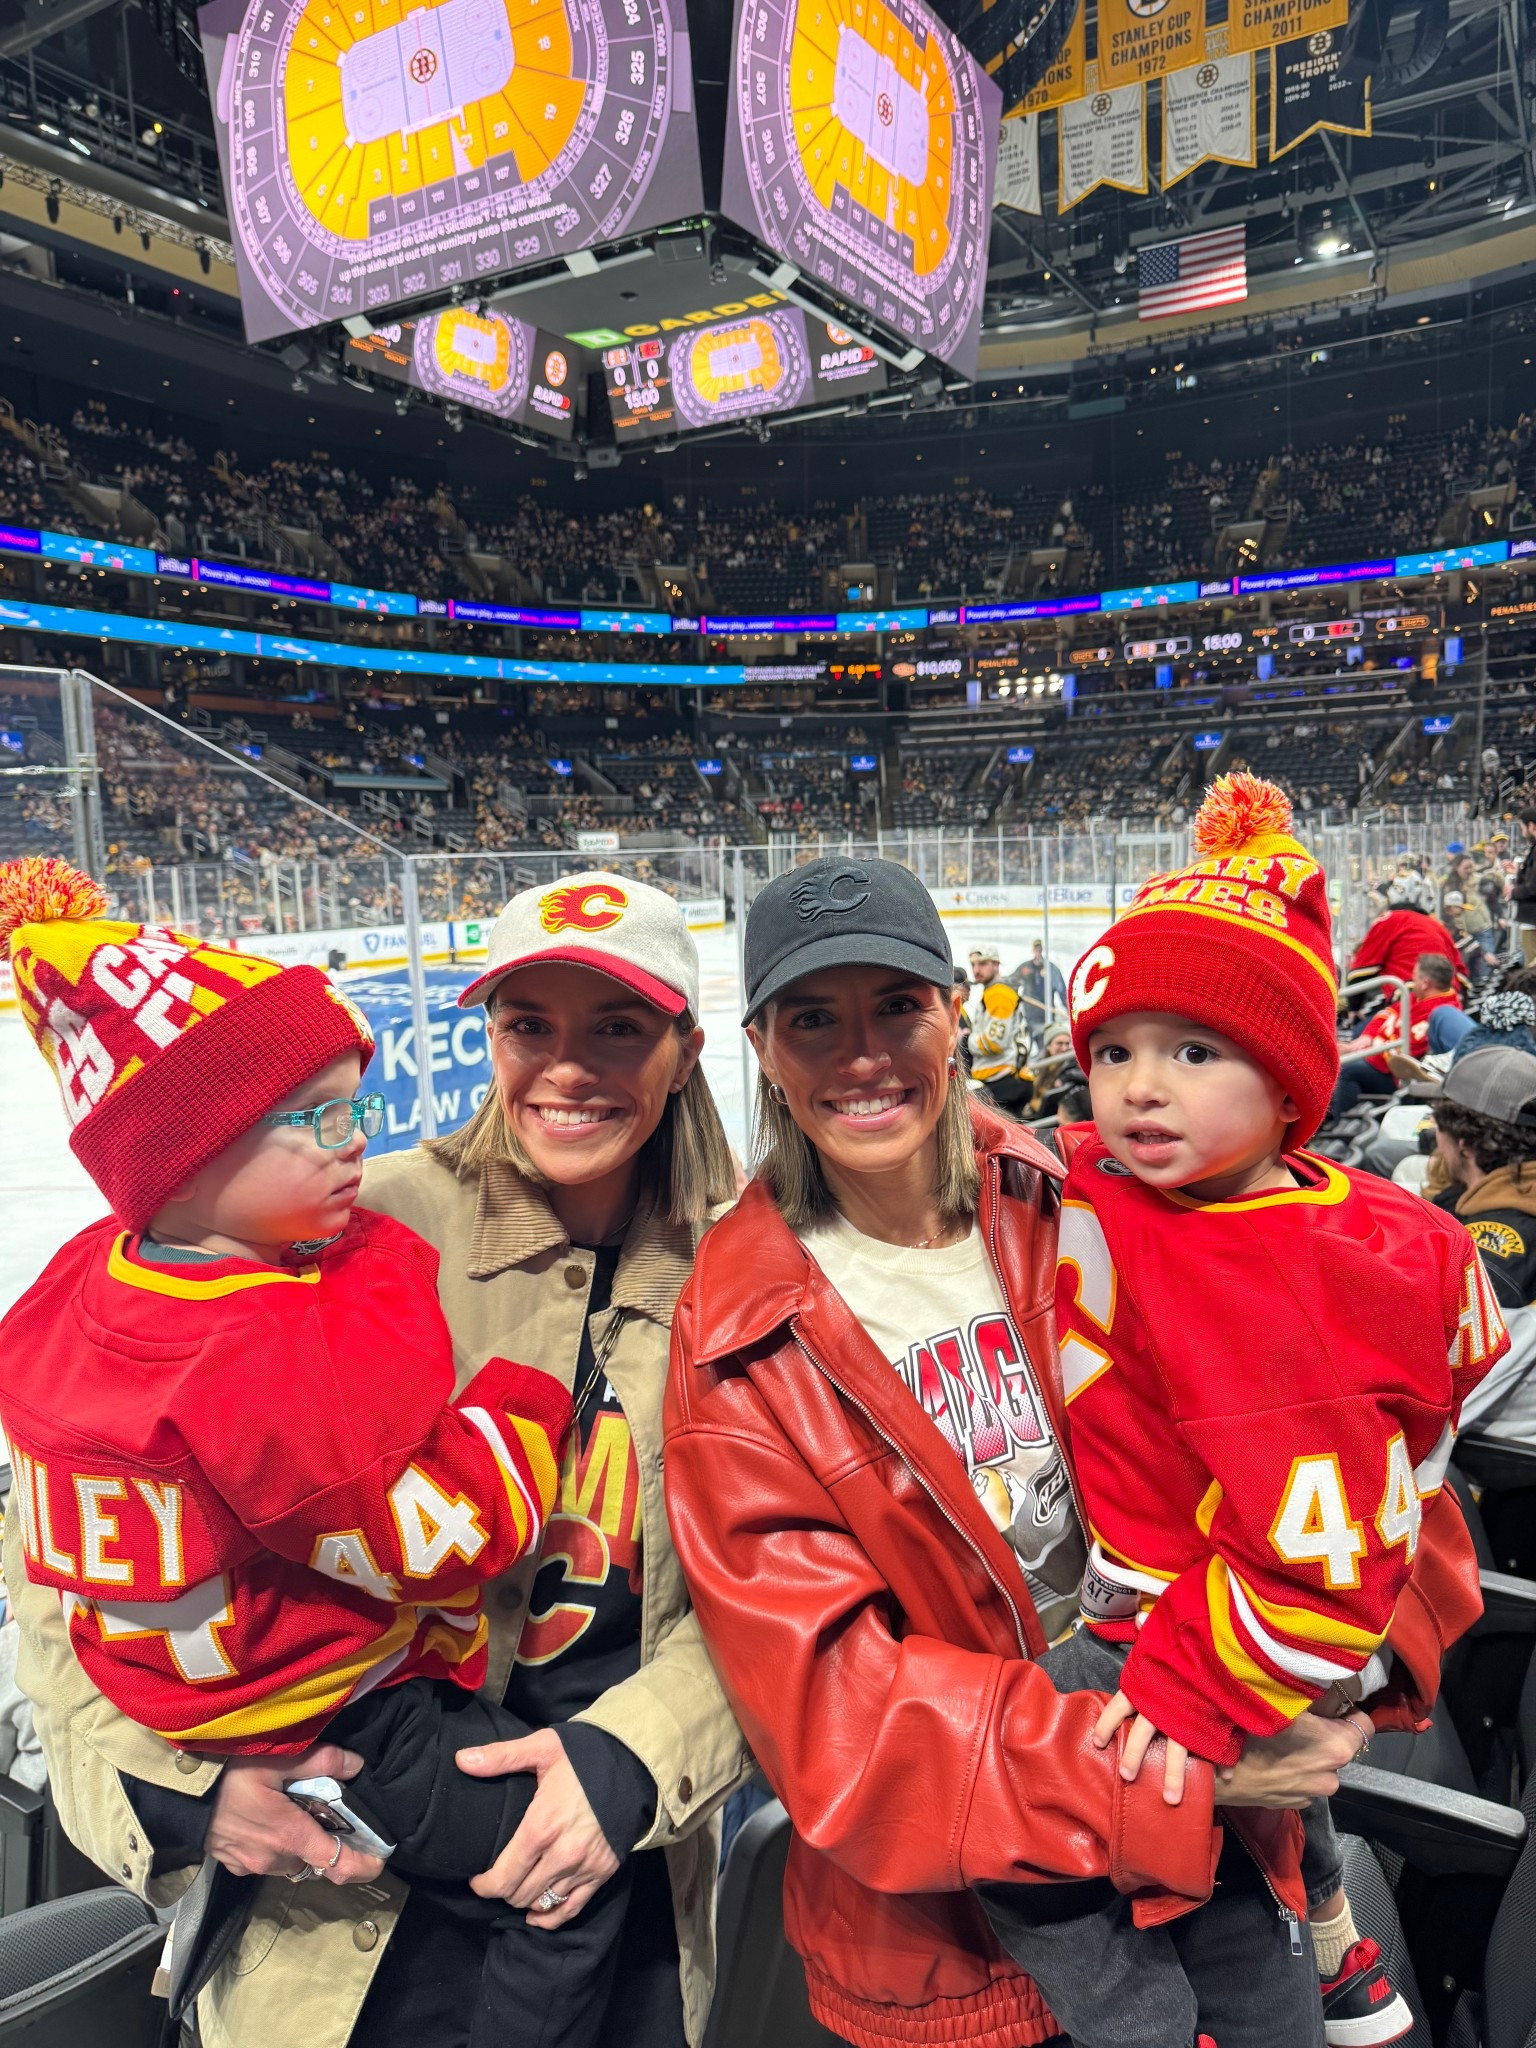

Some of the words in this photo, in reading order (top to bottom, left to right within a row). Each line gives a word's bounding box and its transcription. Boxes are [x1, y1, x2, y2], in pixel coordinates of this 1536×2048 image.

[756, 9, 768, 42] 308
[1243, 0, 1331, 28] CHAMPION
[1112, 19, 1164, 48] STANLEY
[1168, 11, 1191, 31] CUP
[1272, 16, 1302, 38] 2011
[538, 36, 551, 51] 18
[1111, 29, 1192, 66] CHAMPIONS
[249, 50, 262, 78] 310
[630, 50, 645, 86] 325
[1138, 55, 1166, 77] 1972
[756, 71, 766, 106] 307
[1022, 90, 1049, 109] 1970
[544, 104, 557, 121] 19
[493, 121, 509, 139] 20
[615, 109, 635, 146] 326
[761, 128, 776, 165] 306
[590, 163, 613, 200] 327
[255, 196, 272, 224] 307
[773, 186, 790, 221] 305
[554, 207, 581, 238] 328
[273, 235, 292, 265] 306
[514, 235, 540, 259] 329
[475, 247, 500, 271] 330
[440, 260, 462, 282] 301
[297, 270, 319, 296] 305
[367, 283, 391, 306] 303
[402, 272, 427, 295] 302
[330, 285, 353, 305] 304
[614, 367, 626, 386] 0
[647, 359, 659, 379] 0
[624, 387, 660, 410] 15:00
[158, 556, 190, 574] jetBlue
[1200, 581, 1231, 596] jetBlue
[673, 618, 700, 631] jetBlue
[929, 610, 958, 624] jetBlue
[1387, 618, 1397, 631] 0
[1203, 632, 1242, 650] 15:00
[1303, 627, 1314, 640] 0
[1166, 639, 1177, 654] 0
[916, 659, 962, 676] $10,000
[1038, 886, 1092, 905] jtBlue
[383, 933, 437, 948] FANUEL
[381, 1016, 492, 1081] KEC
[1268, 1430, 1422, 1590] 44
[1087, 1580, 1114, 1604] 4/7
